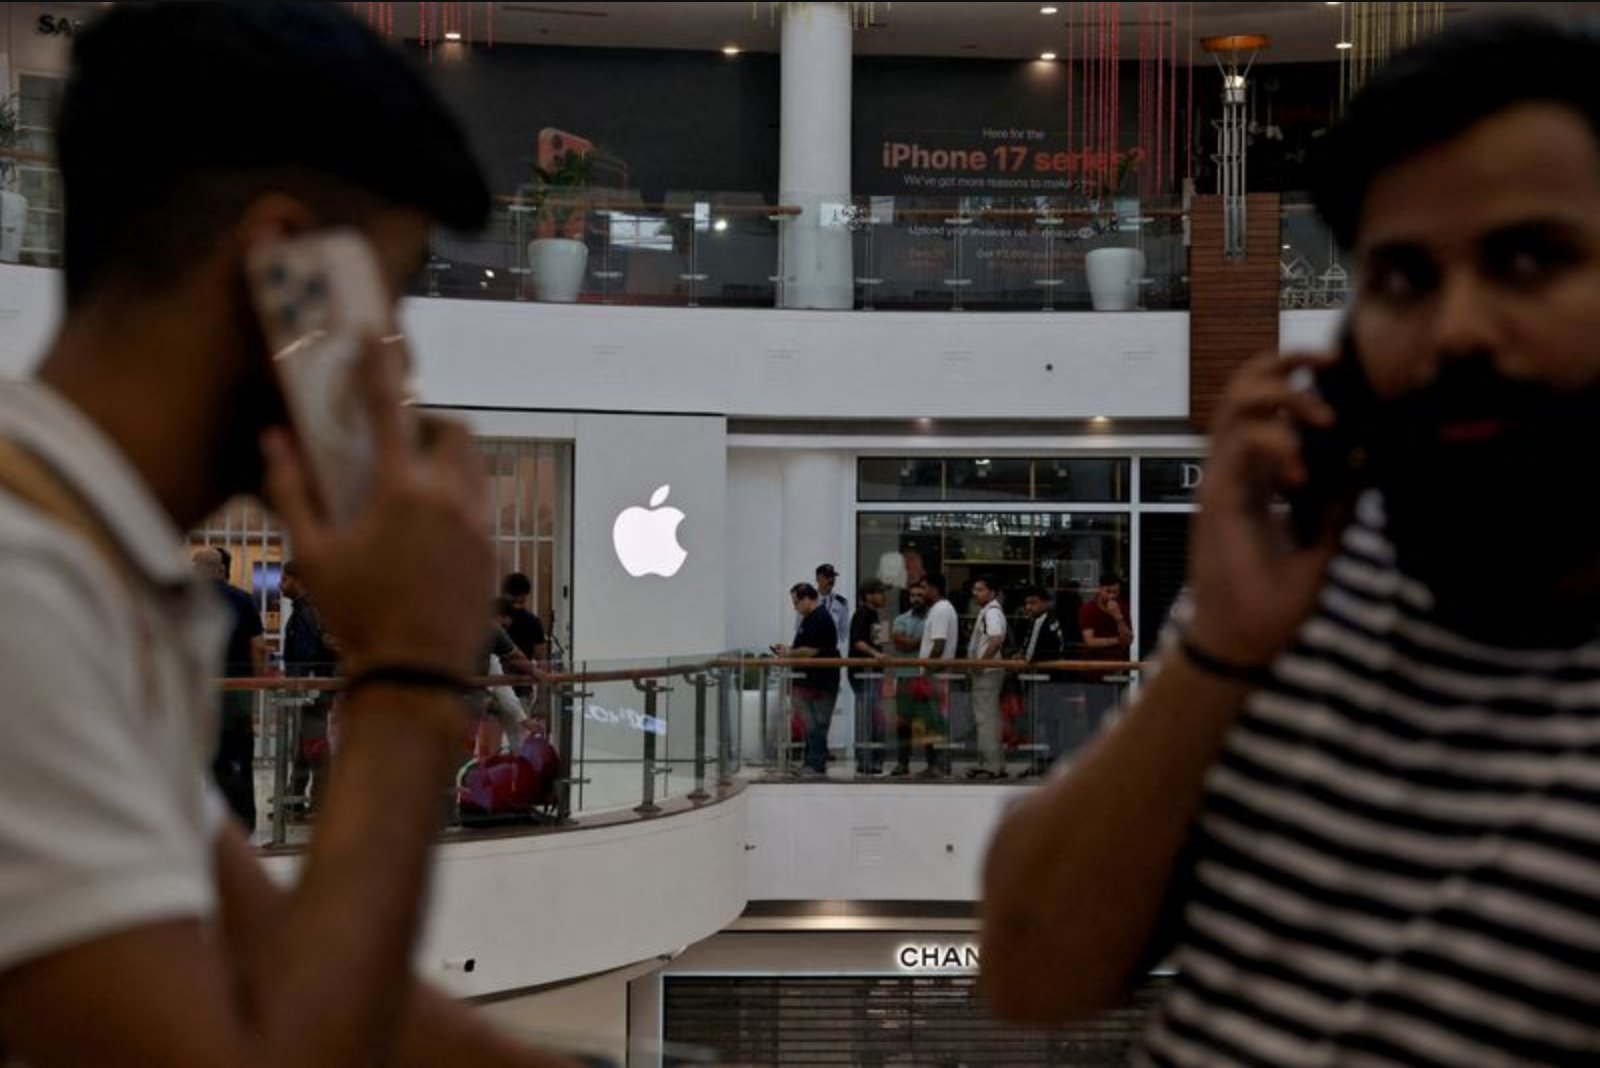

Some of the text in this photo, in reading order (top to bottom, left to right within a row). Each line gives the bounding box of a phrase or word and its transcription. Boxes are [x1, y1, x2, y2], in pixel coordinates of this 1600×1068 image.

[39, 14, 79, 35] SA
[983, 127, 1045, 140] Here for the
[882, 141, 987, 170] iPhone
[993, 145, 1026, 172] 17
[1180, 463, 1204, 488] D
[900, 946, 980, 967] CHAN
